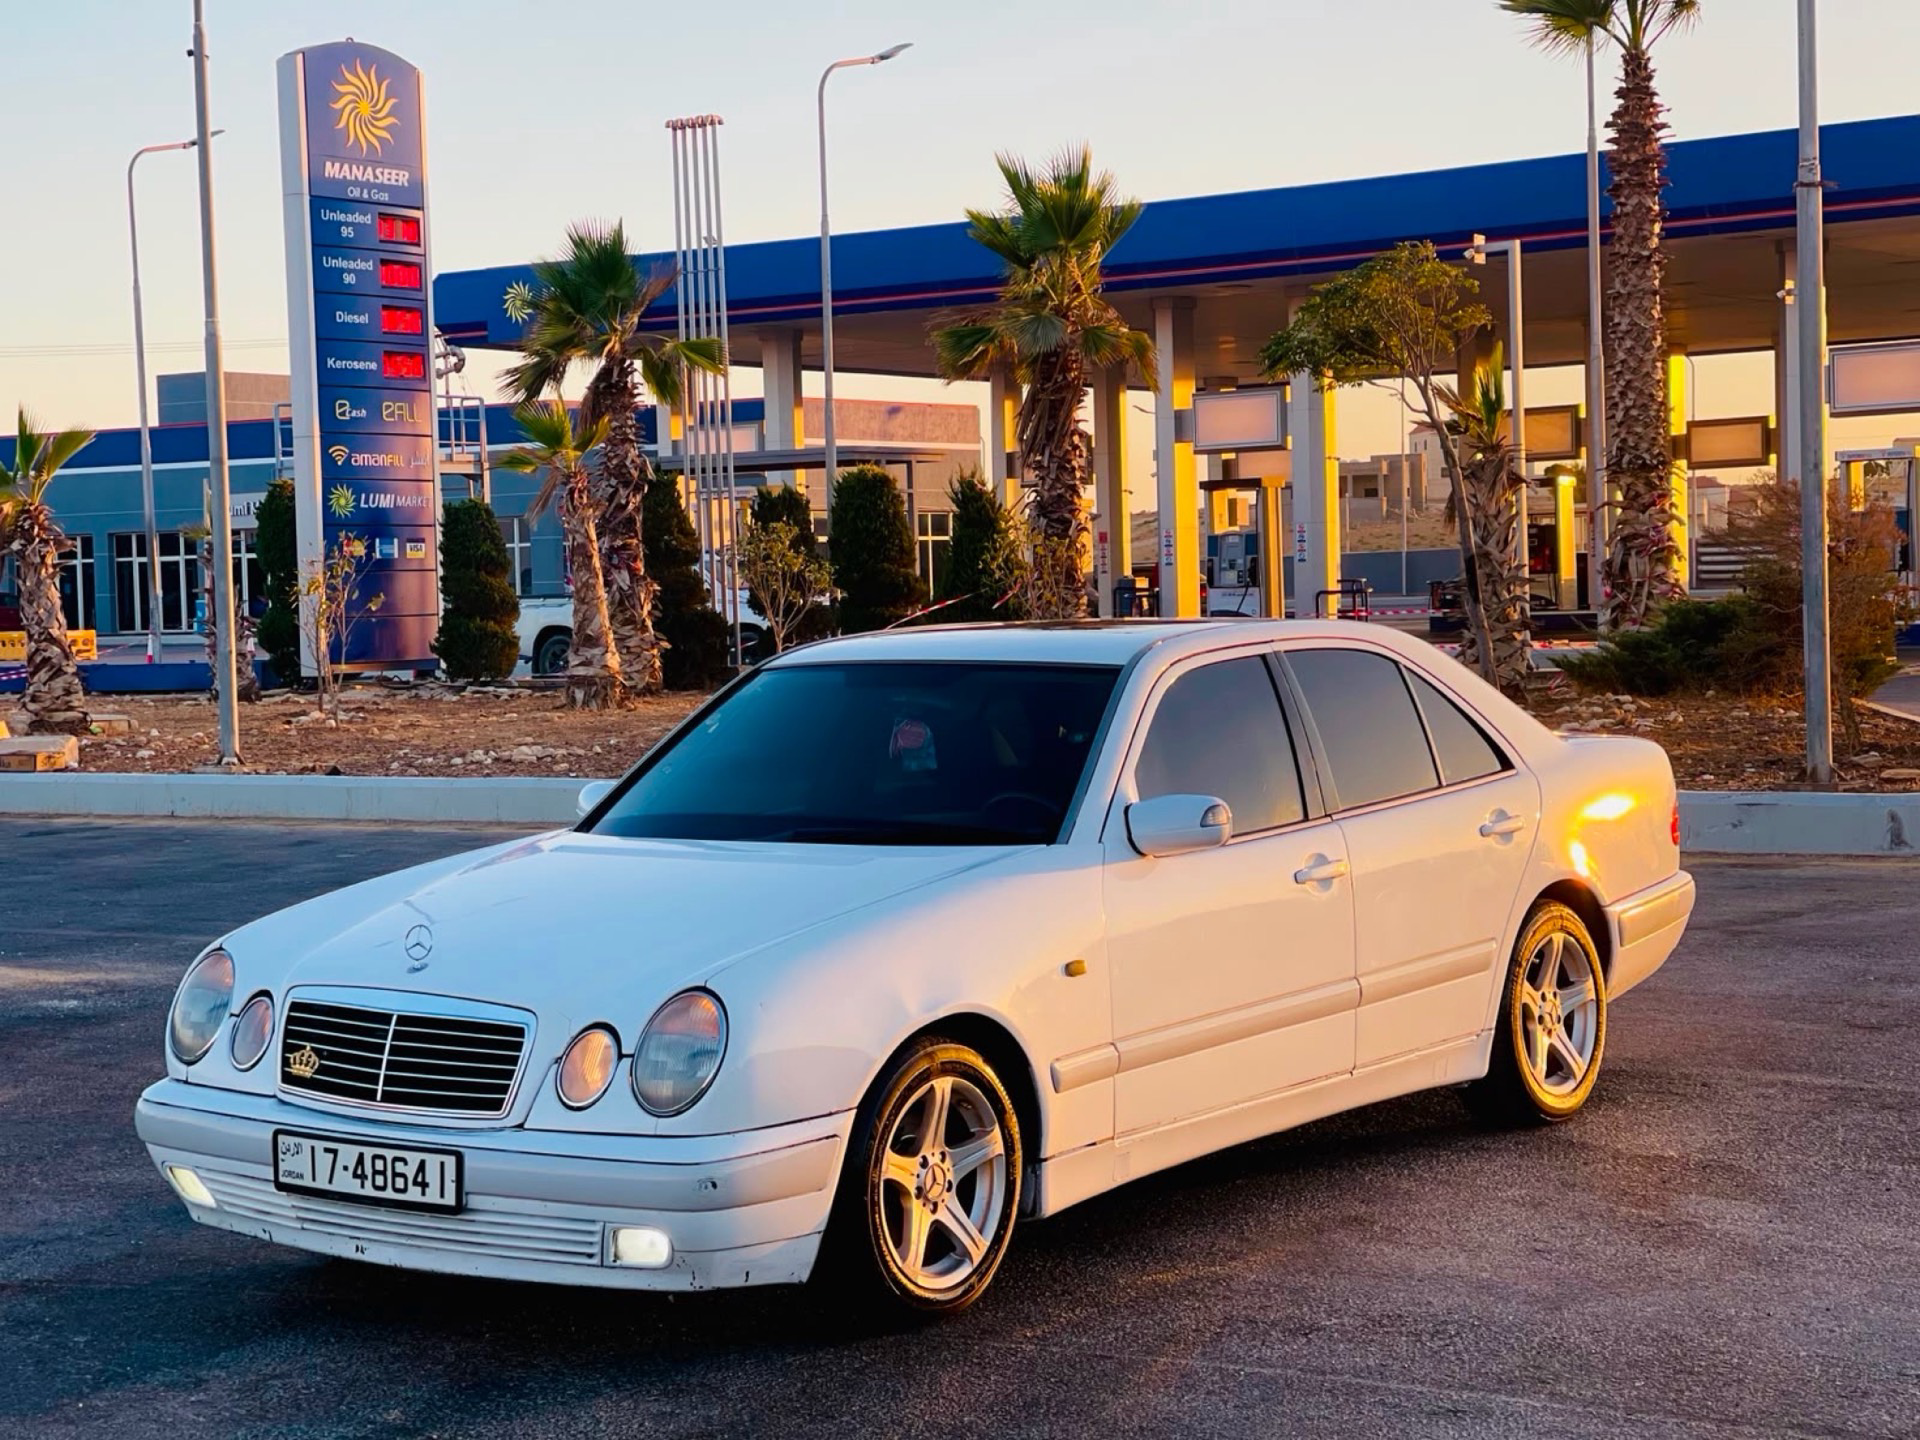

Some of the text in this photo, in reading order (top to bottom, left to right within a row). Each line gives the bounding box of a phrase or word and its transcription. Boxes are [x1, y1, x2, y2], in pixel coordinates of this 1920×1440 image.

[324, 161, 409, 187] MANASEER
[347, 186, 389, 201] Oil & Gas
[321, 209, 371, 224] Unleaded
[340, 226, 354, 238] 95
[323, 256, 373, 271] Unleaded
[342, 273, 356, 285] 90
[336, 311, 369, 324] Diesel
[326, 357, 377, 371] Kerosene
[360, 493, 432, 509] LUMI MARKET
[281, 1169, 305, 1181] JORDAN
